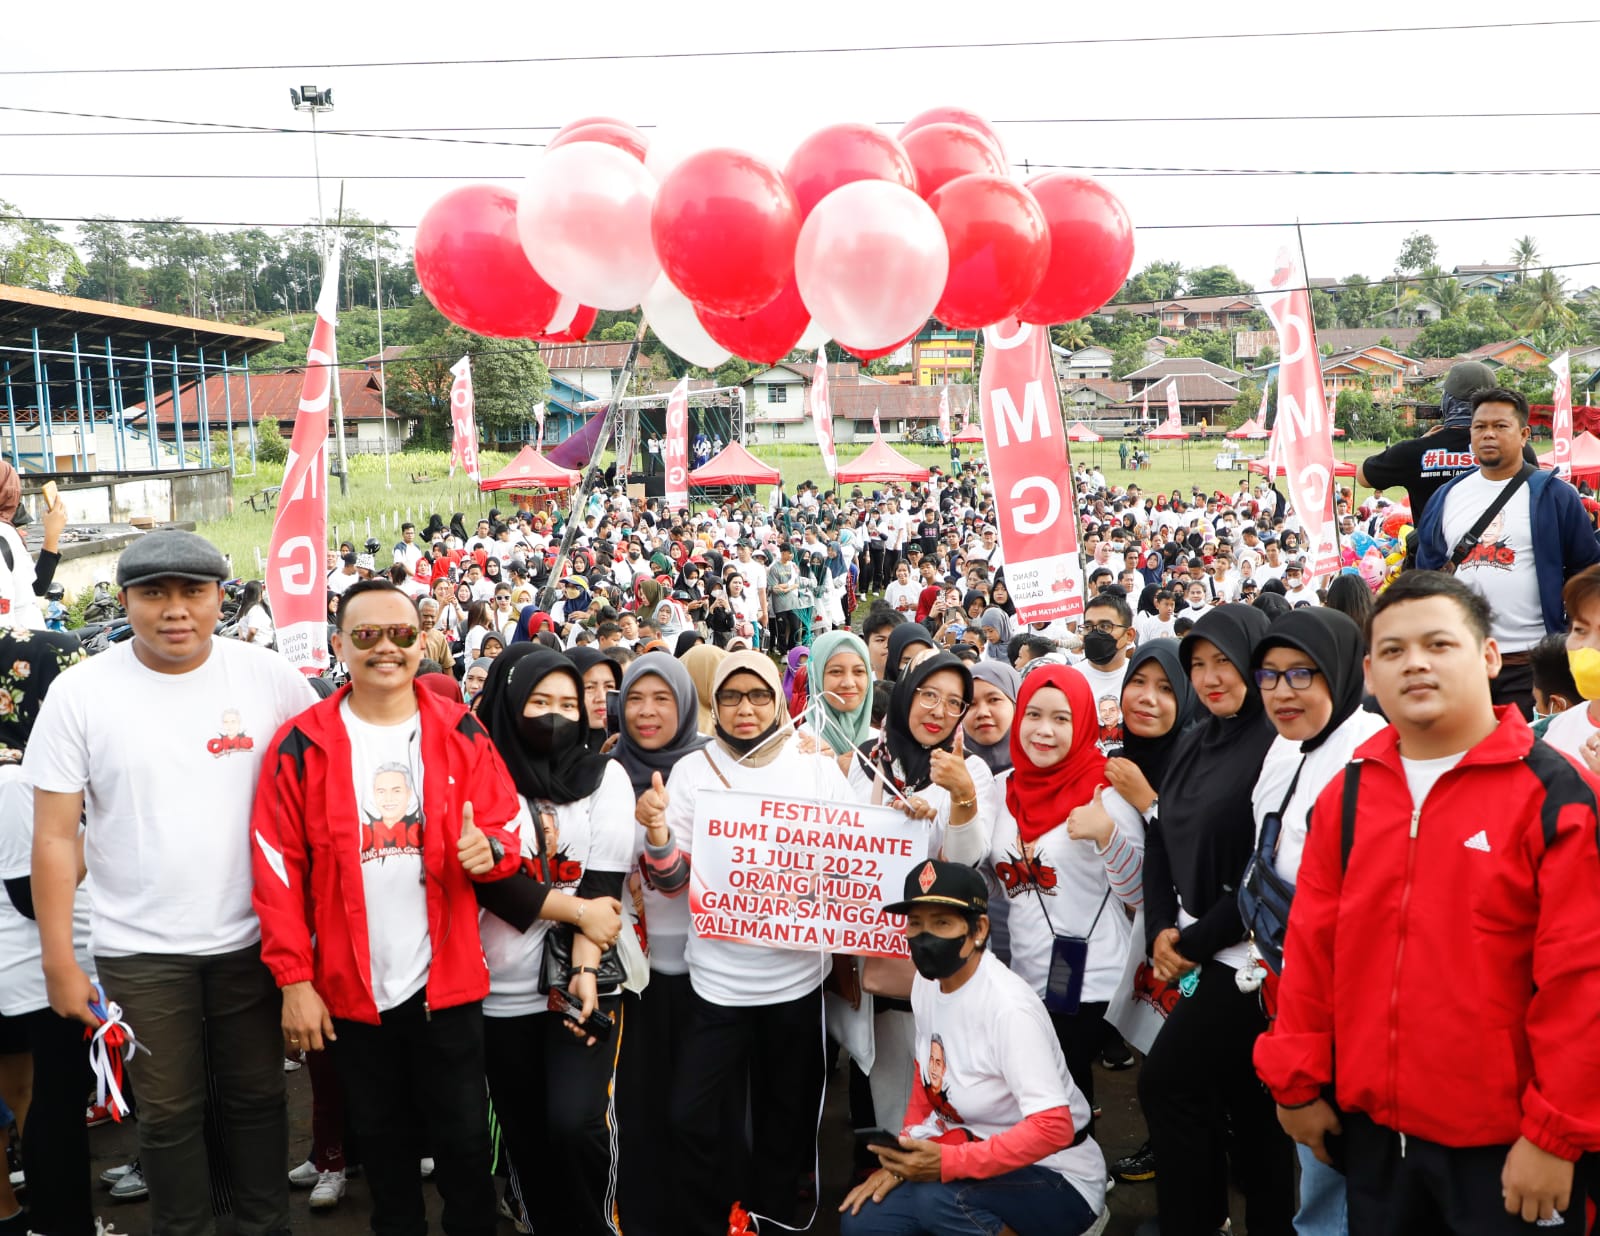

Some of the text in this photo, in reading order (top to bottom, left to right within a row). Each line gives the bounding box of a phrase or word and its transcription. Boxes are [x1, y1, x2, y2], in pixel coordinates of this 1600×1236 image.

[760, 800, 865, 828] FESTIVAL
[708, 819, 913, 857] BUMI DARANANTE
[731, 846, 884, 881] 31 JULI 2022,
[728, 870, 883, 902] ORANG MUDA
[702, 891, 906, 928] GANJAR SANGGAU
[694, 914, 836, 946] KALIMANTAN
